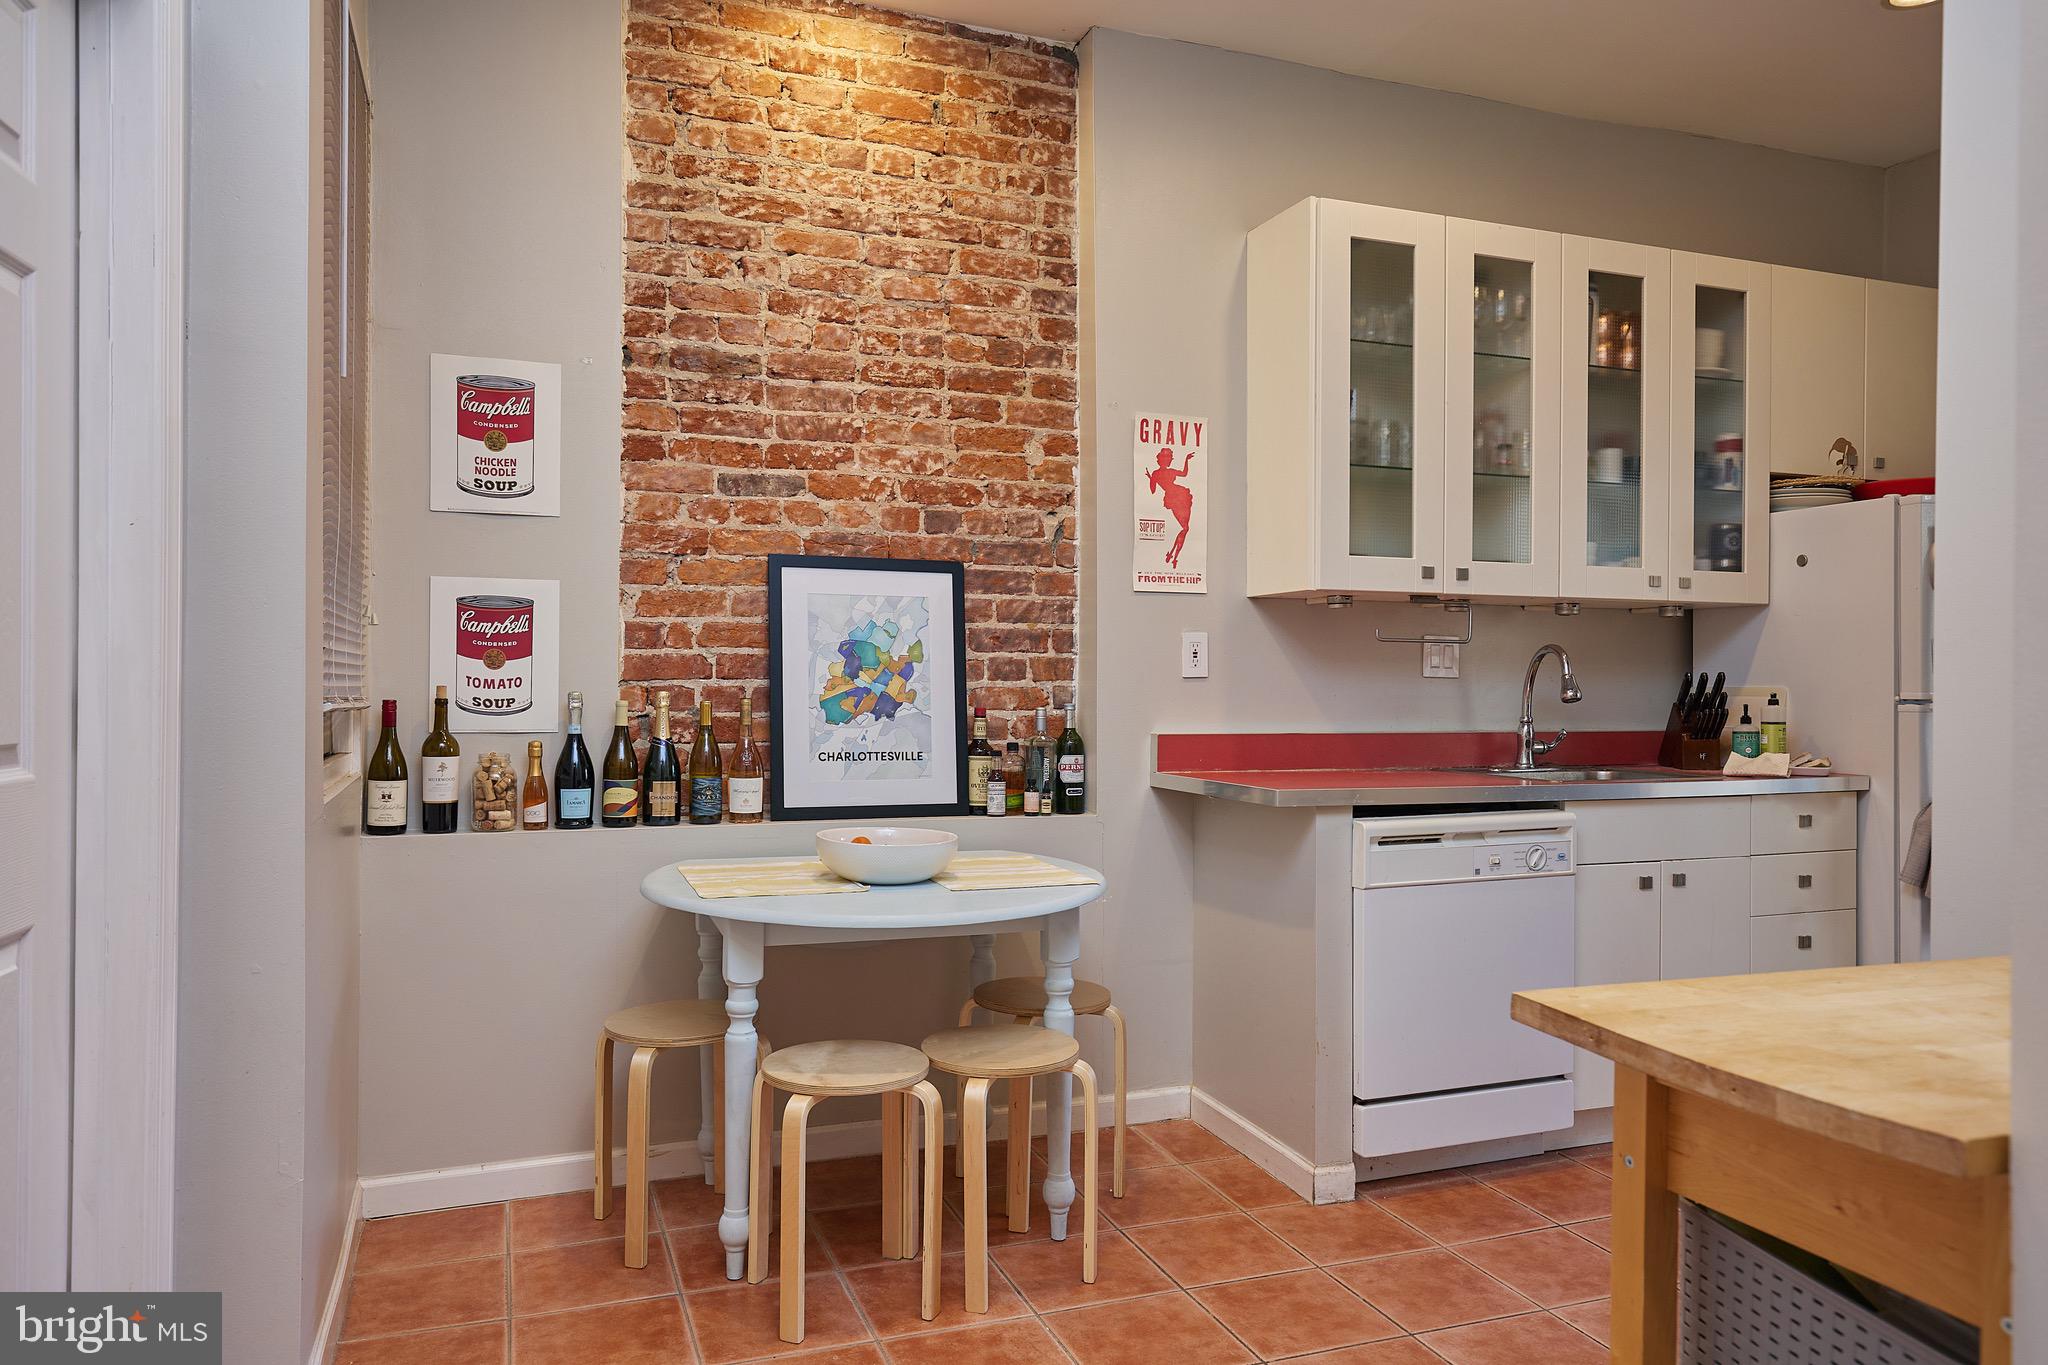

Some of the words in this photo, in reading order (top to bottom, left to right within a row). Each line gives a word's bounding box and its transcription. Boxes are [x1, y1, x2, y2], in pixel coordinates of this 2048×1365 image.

[460, 390, 531, 419] Campbell's
[473, 420, 519, 429] CONDENSED
[1140, 418, 1202, 447] GRAVY
[474, 456, 517, 467] CHICKEN
[474, 466, 517, 477] NOODLE
[473, 478, 518, 492] SOUP
[1186, 576, 1202, 584] HIP
[460, 610, 530, 638] Campbell's
[472, 639, 518, 647] CONDENSED
[465, 675, 523, 690] TOMATO
[472, 696, 516, 709] SOUP
[818, 751, 924, 762] CHARLOTTESVILLE
